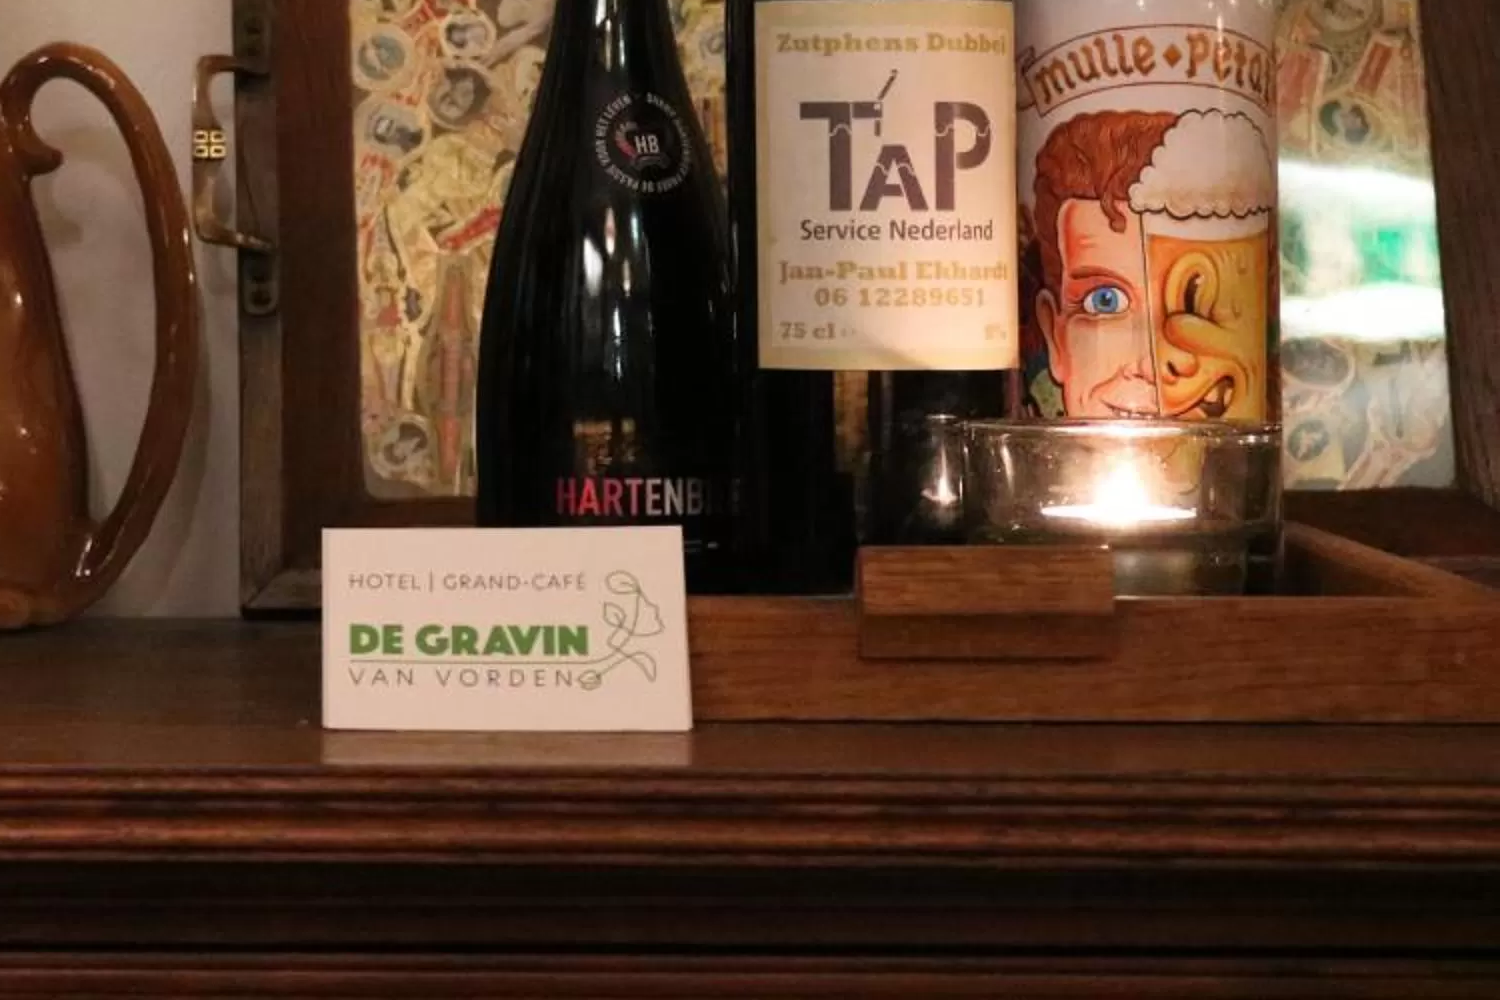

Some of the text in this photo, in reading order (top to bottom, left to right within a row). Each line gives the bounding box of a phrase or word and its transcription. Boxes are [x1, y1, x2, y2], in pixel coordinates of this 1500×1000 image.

[776, 32, 919, 56] Zutphens
[633, 134, 660, 154] HB
[798, 100, 992, 212] TAP
[799, 219, 994, 242] Service Nederland
[779, 260, 908, 285] Jan-Paul
[814, 287, 850, 308] 06
[779, 322, 837, 341] 75 cl
[555, 477, 710, 516] HARTENB
[348, 573, 421, 591] HOTEL
[349, 624, 589, 656] DE GRAVIN
[348, 668, 579, 688] VAN VORDEN
